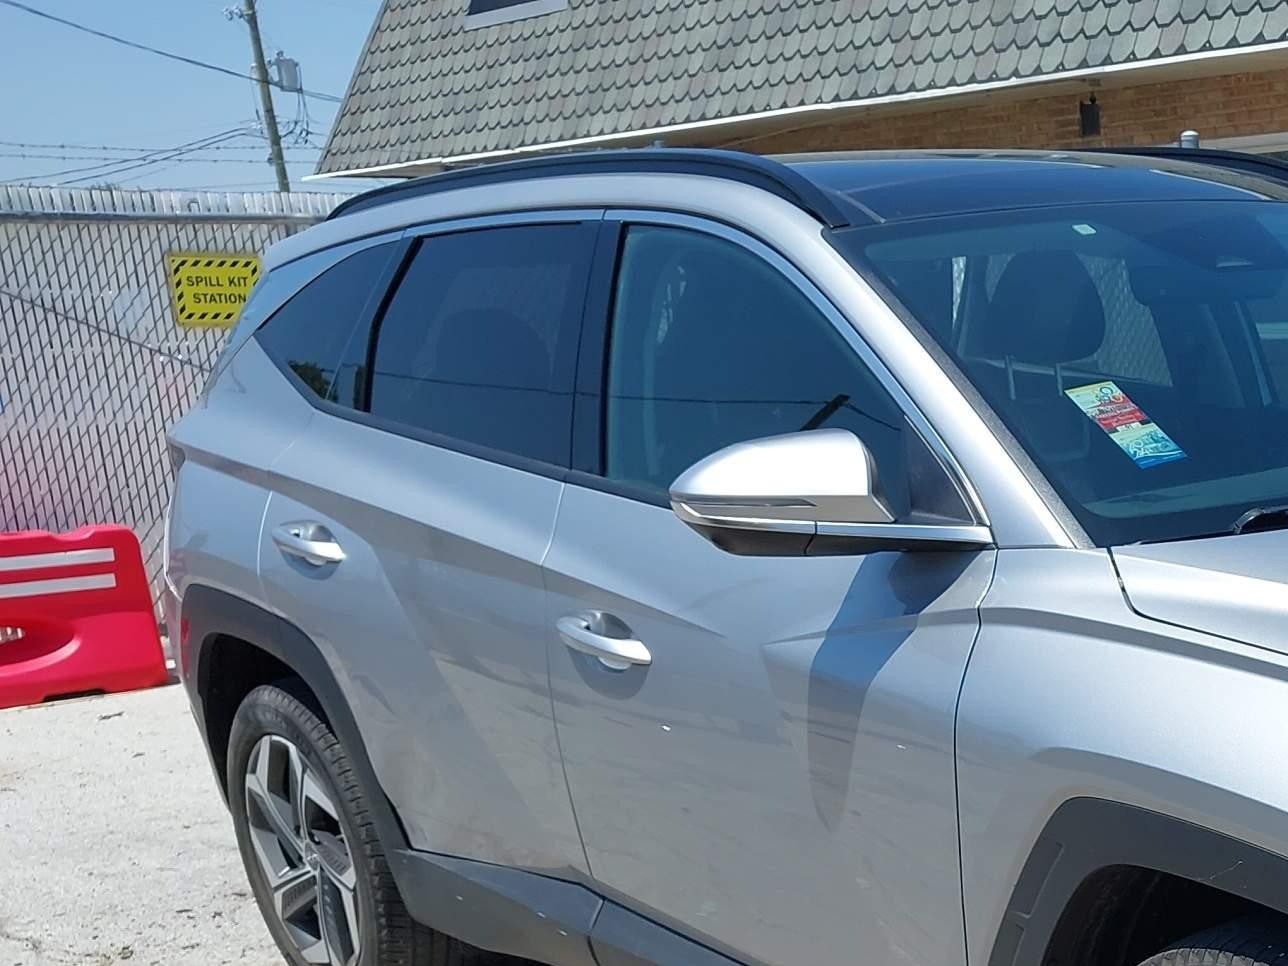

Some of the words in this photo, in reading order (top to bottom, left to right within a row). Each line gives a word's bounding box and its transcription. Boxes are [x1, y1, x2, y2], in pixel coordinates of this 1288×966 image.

[186, 276, 223, 287] SPILL
[228, 276, 248, 287] KIT
[193, 293, 247, 304] STATION
